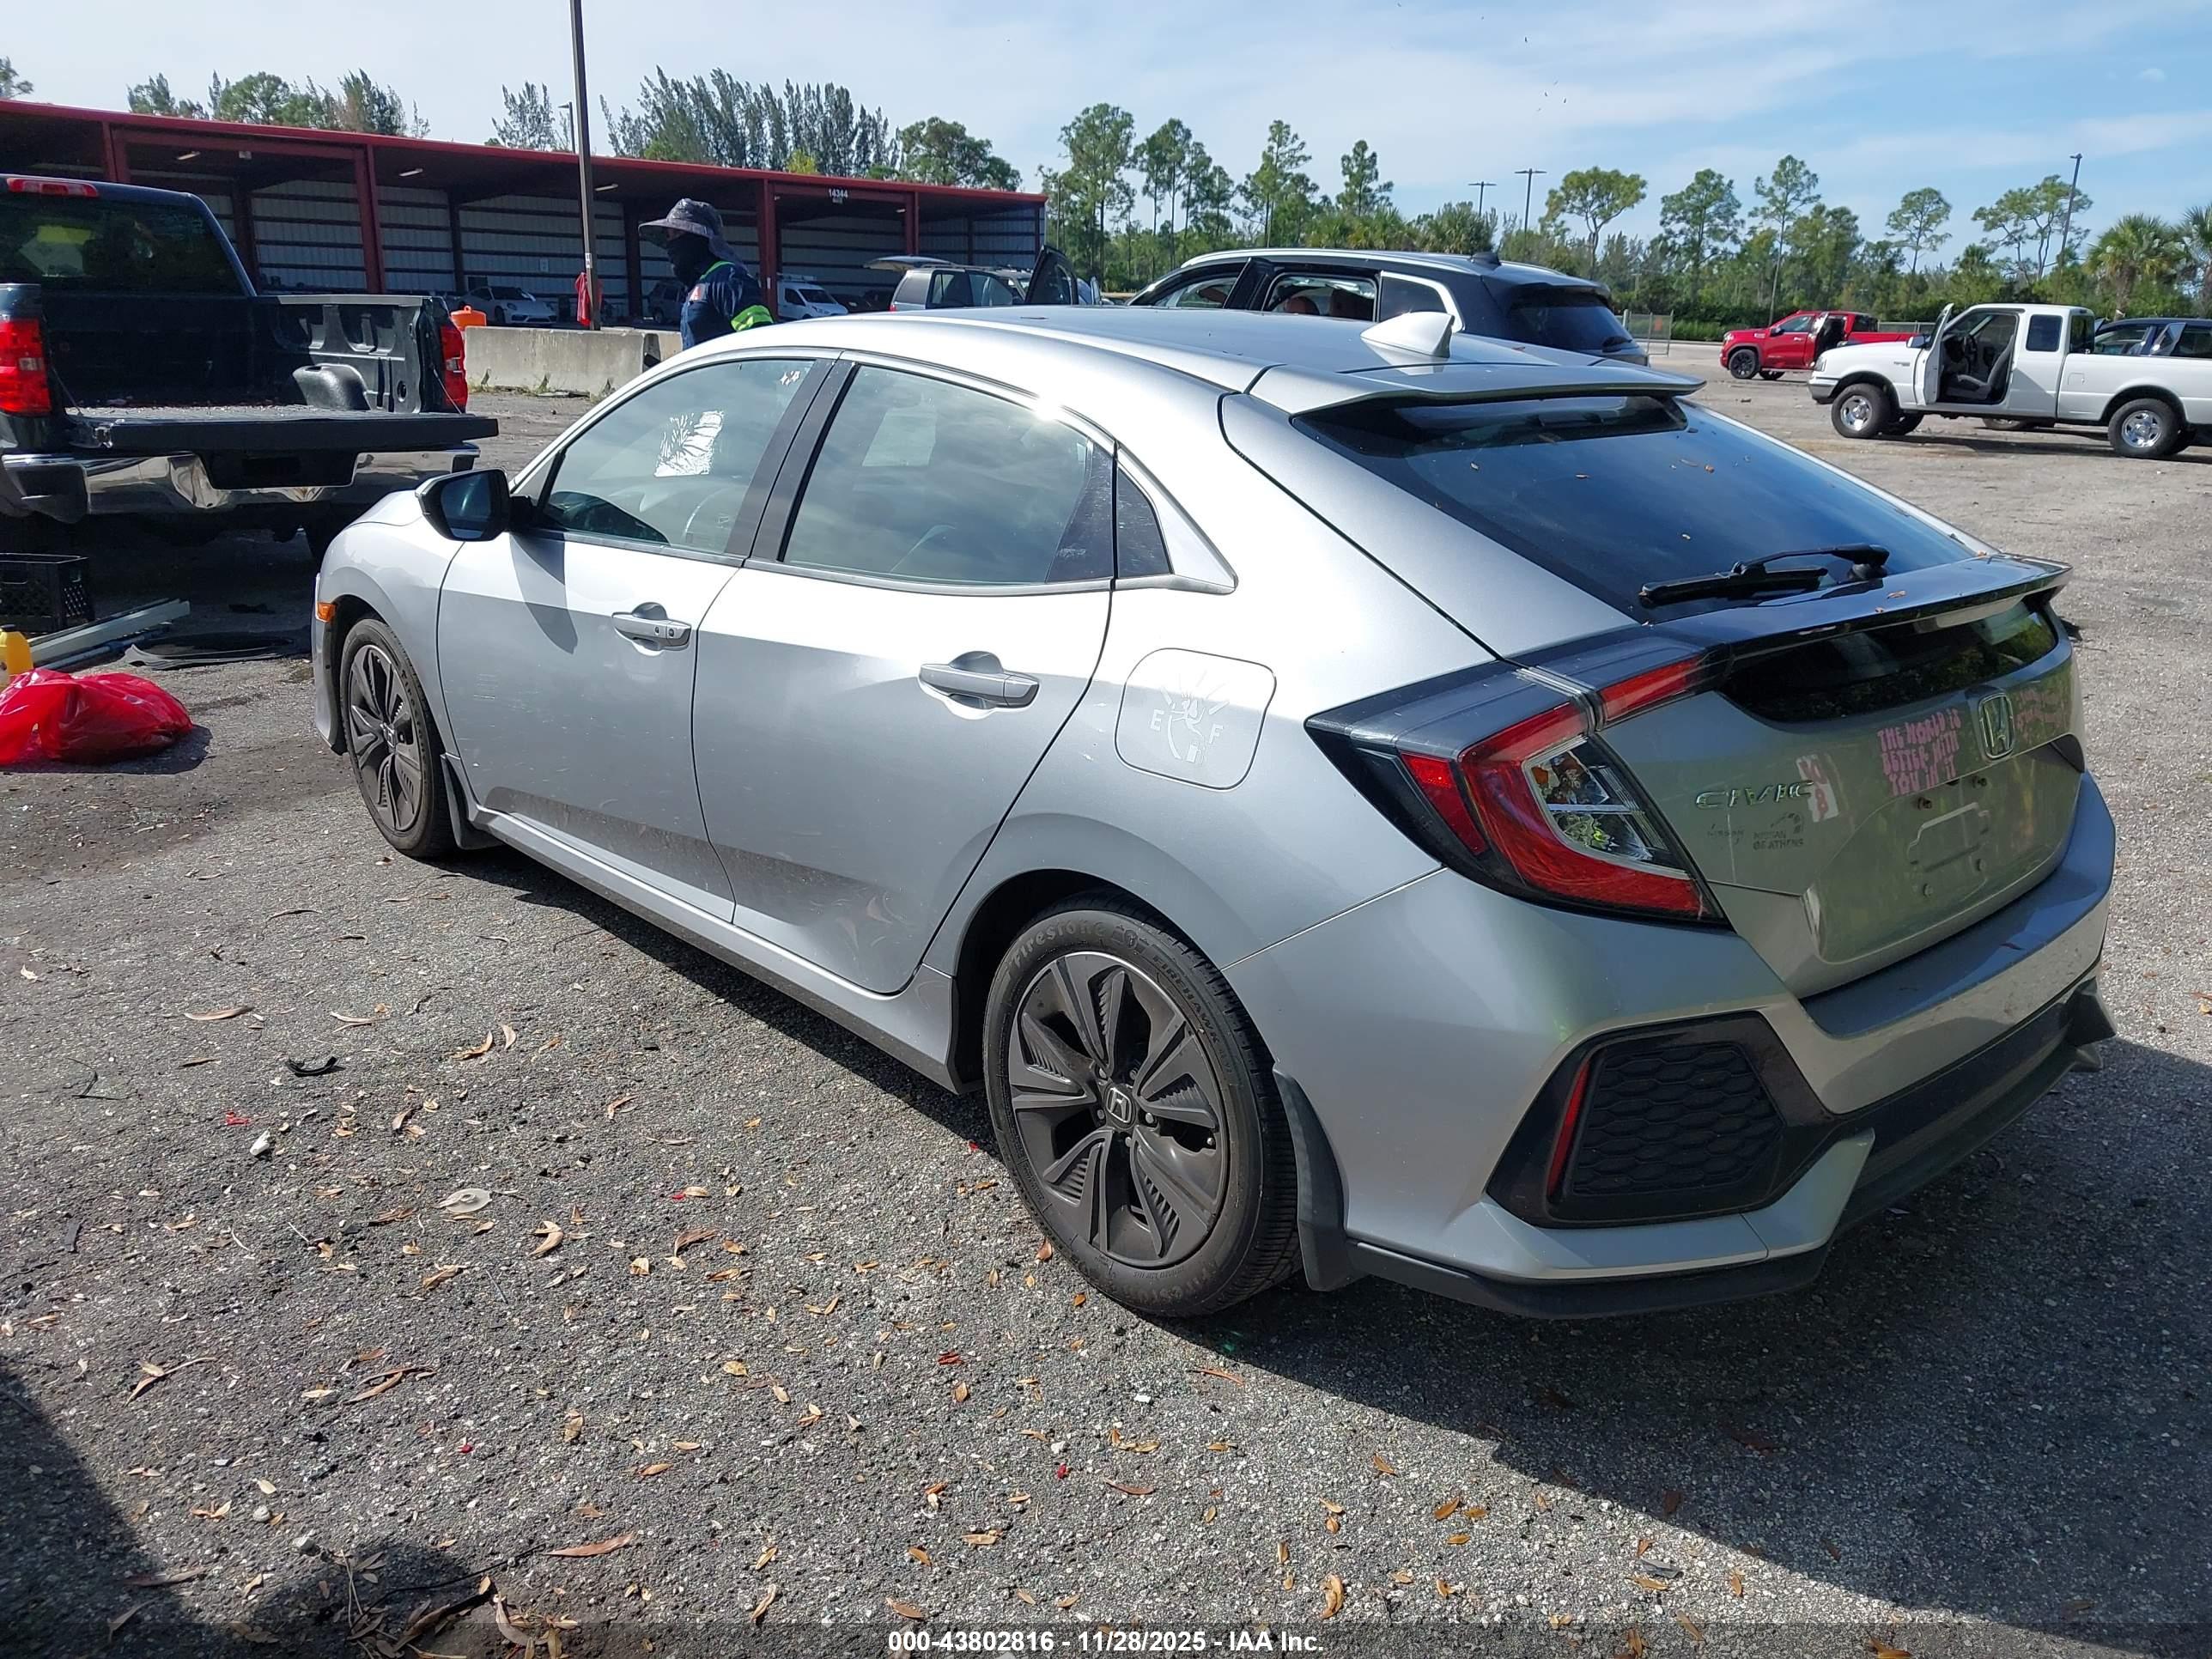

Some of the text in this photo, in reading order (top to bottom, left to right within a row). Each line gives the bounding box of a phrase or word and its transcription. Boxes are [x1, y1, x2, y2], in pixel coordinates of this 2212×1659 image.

[829, 188, 848, 198] 14344
[1150, 708, 1164, 731] E
[1209, 724, 1224, 744] F
[1877, 726, 1905, 752] THE
[1695, 779, 1814, 810] CIVIC
[1010, 919, 1107, 966] Firestone
[1152, 954, 1221, 1045] FIREHAWK
